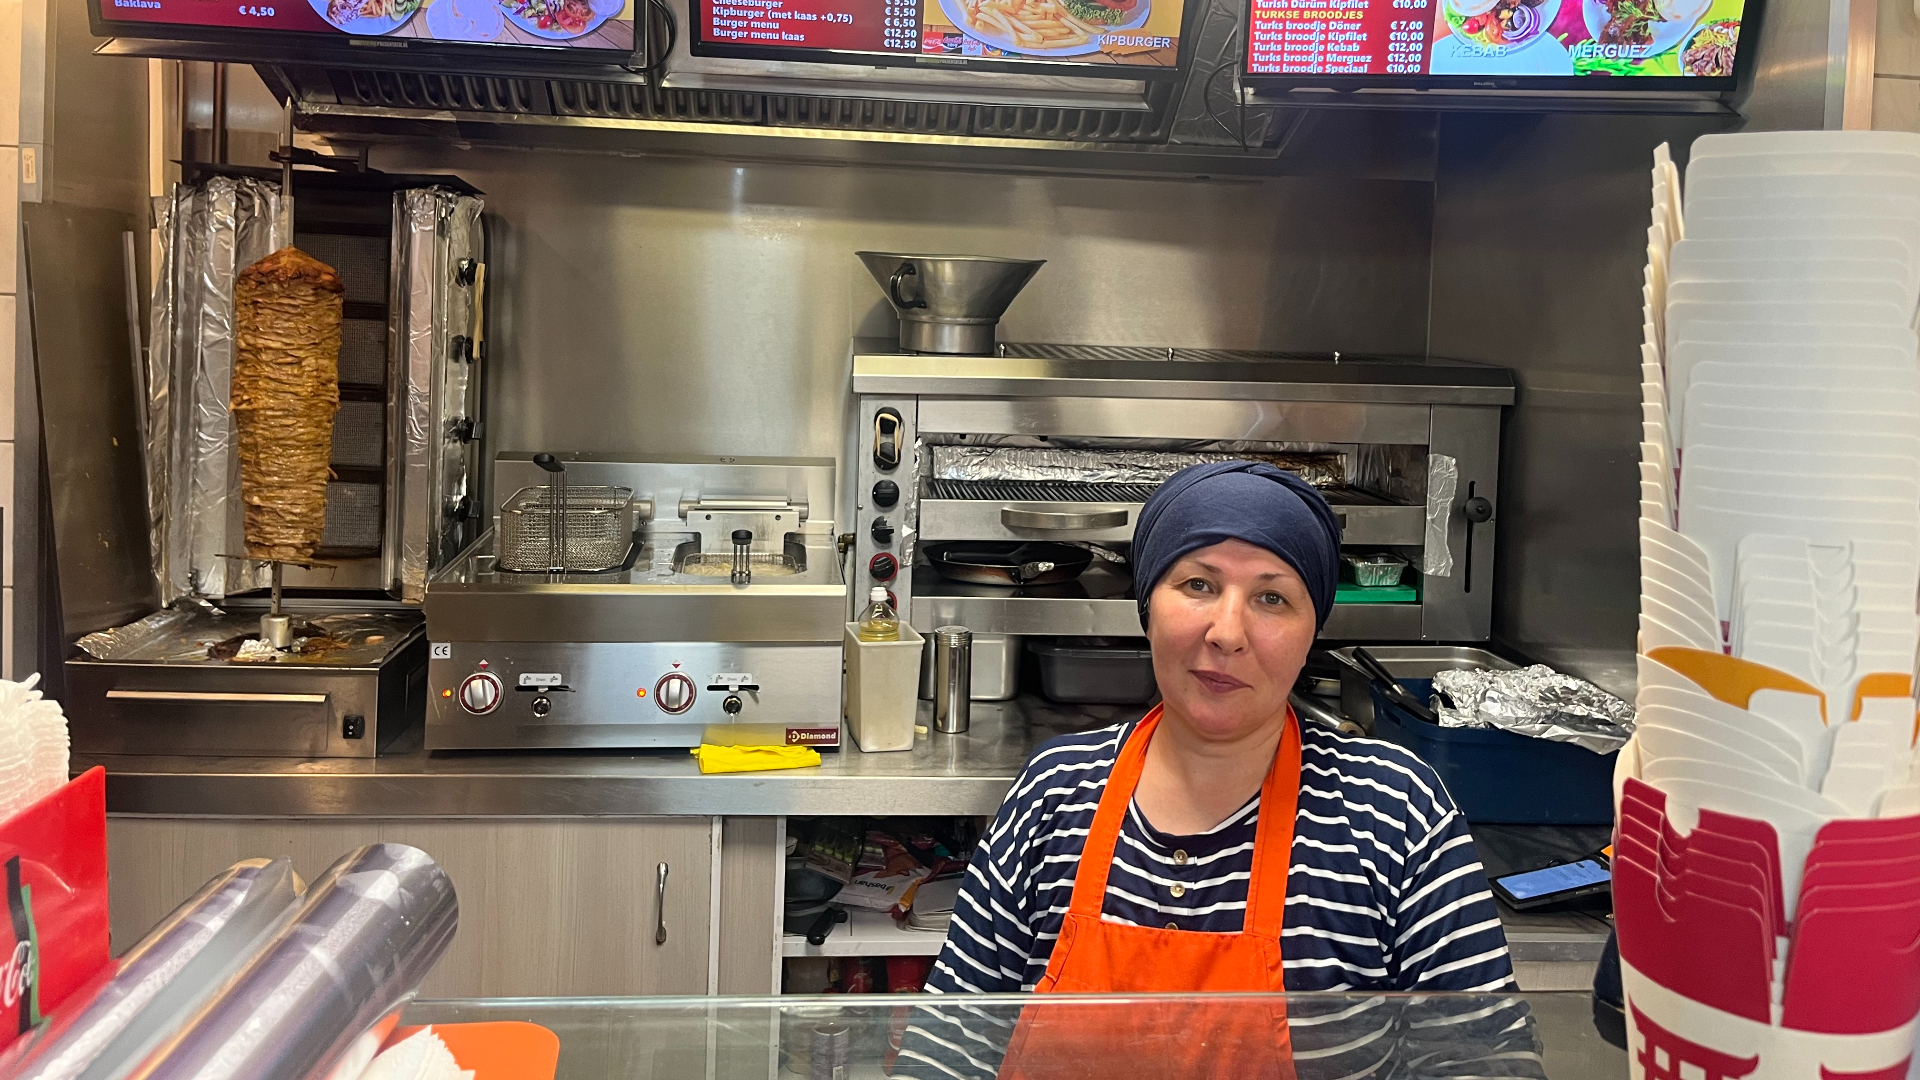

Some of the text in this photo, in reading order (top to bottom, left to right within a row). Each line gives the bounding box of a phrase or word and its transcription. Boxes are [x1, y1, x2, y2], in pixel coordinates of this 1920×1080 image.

[114, 0, 275, 17] Baklava € 4,50
[1290, 0, 1327, 8] Dürüm
[1329, 0, 1369, 10] Kipfilet
[1392, 0, 1427, 9] €10,00
[712, 6, 916, 28] Kipburger (met kaas +0,75) € 6,50
[885, 7, 891, 16] €
[894, 8, 916, 17] 5,50
[1254, 10, 1364, 19] TURKSE BROODJES
[713, 18, 917, 38] Burger menu €12,50
[1254, 20, 1423, 32] Turks broodje Döner € 7,00
[713, 28, 748, 40] Burger
[750, 31, 780, 40] menu
[782, 32, 805, 41] kaas
[884, 38, 917, 49] €12,50
[1098, 34, 1170, 48] KIPBURGER
[1254, 31, 1424, 42] Turks broodje Kipfilet €10,00
[1253, 42, 1423, 53] Turks broodje Kebab €12,00
[1450, 44, 1508, 58] KEBAB
[1568, 44, 1654, 58] MERGUEZ
[1253, 53, 1422, 64] Turks broodje Merguez €12,00
[1252, 63, 1421, 74] Turks broodje Speciaal €10,00
[800, 732, 837, 740] Diamond
